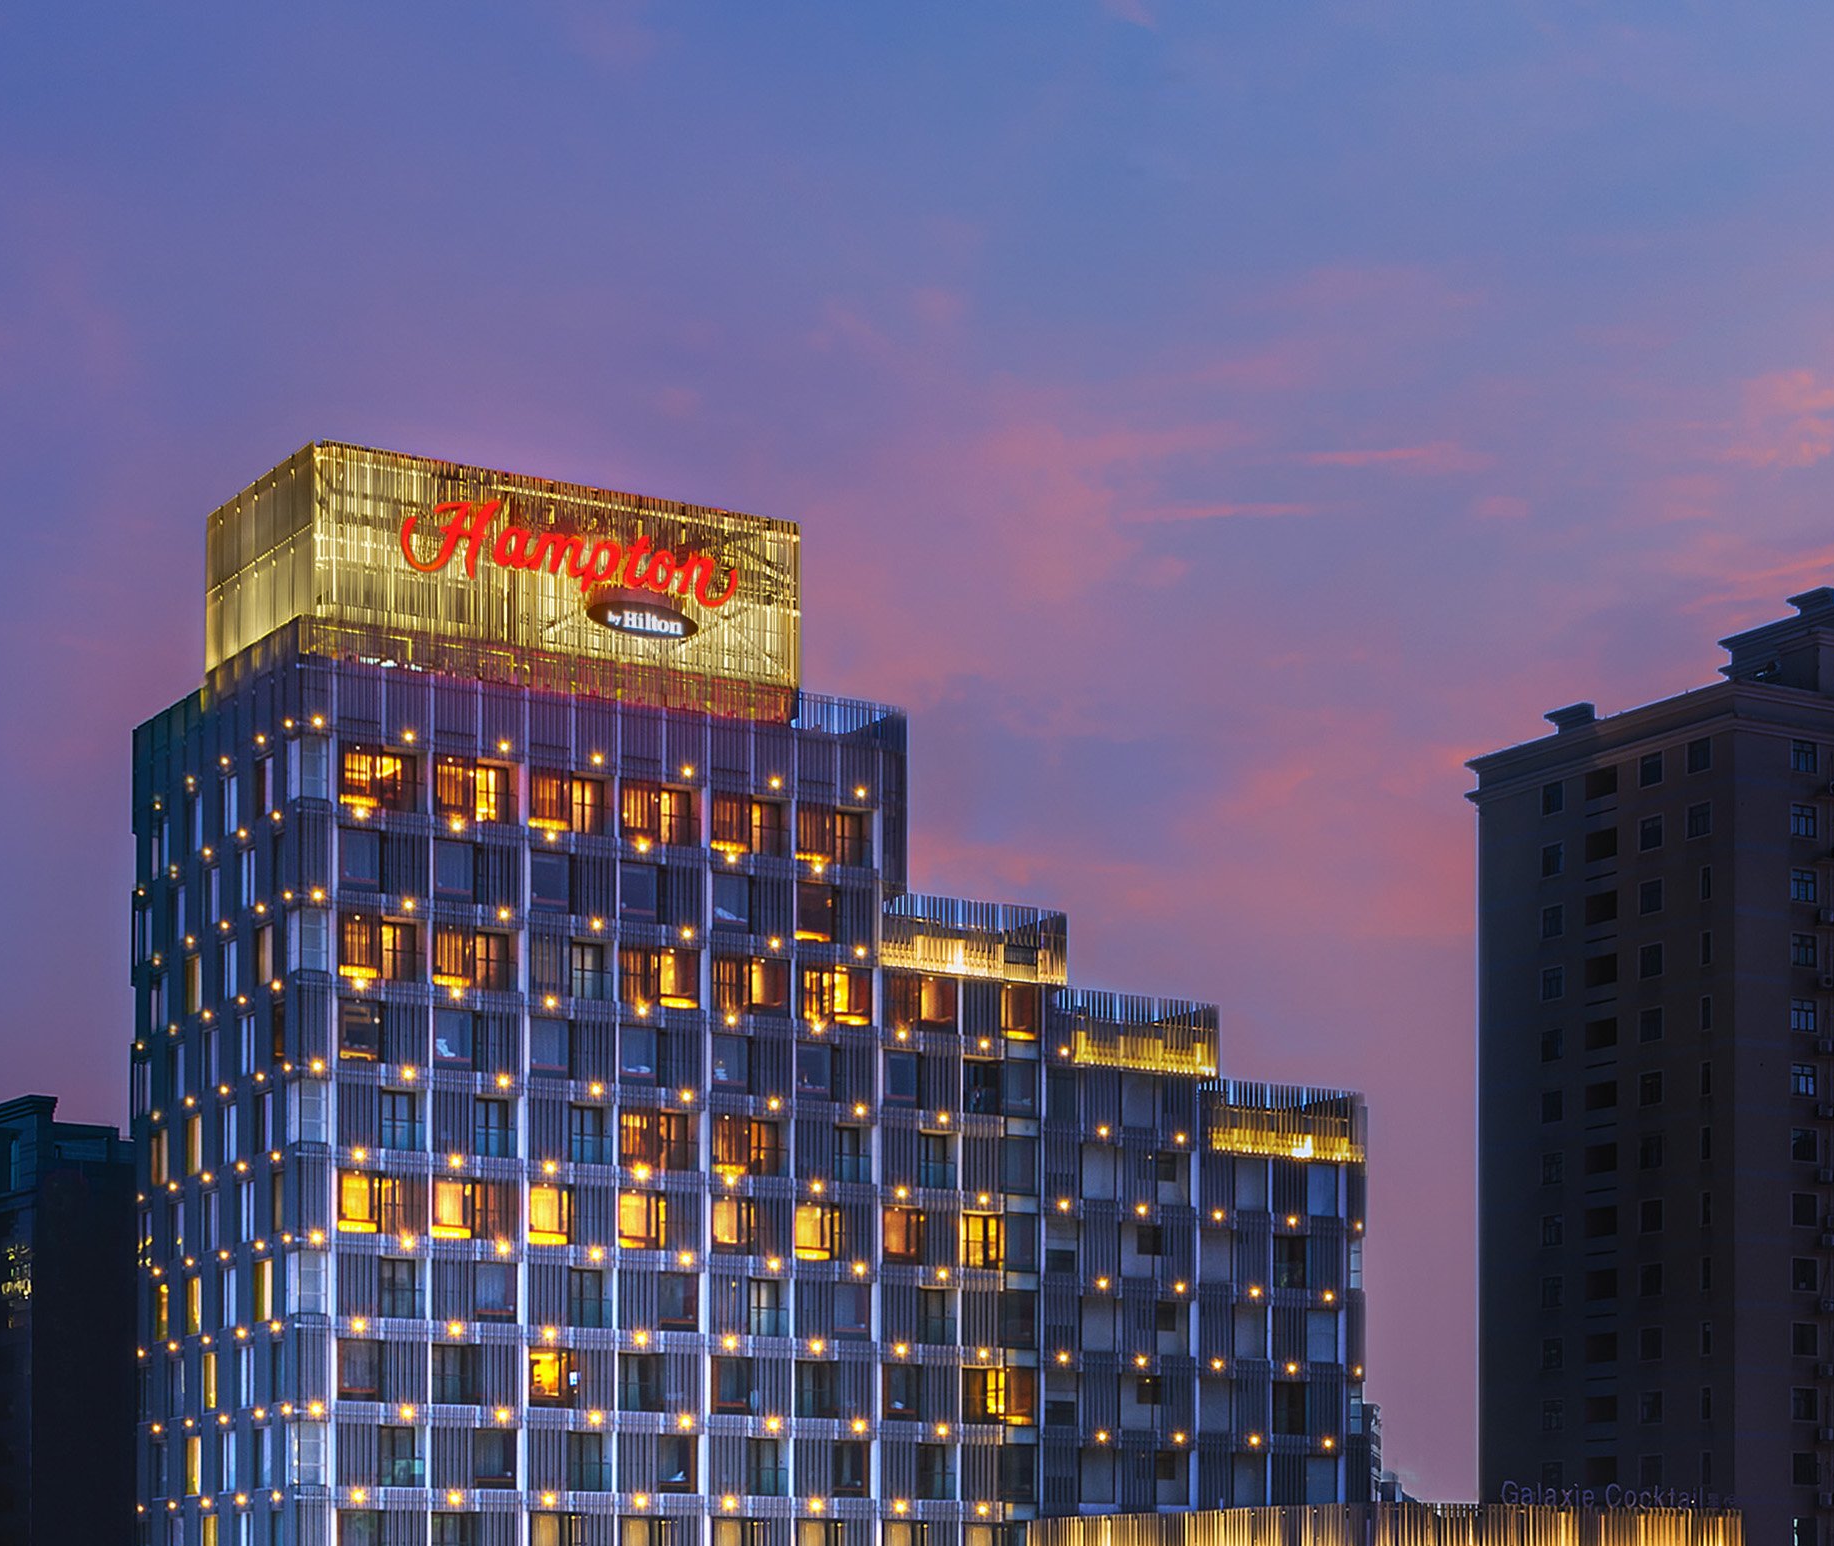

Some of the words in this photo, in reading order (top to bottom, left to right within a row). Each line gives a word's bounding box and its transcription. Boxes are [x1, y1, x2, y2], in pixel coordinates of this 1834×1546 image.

[401, 499, 738, 608] Hampton
[607, 610, 622, 626] by
[623, 610, 683, 635] Hilton
[1501, 1480, 1595, 1507] Galaxie
[1605, 1483, 1703, 1509] Cocktail
